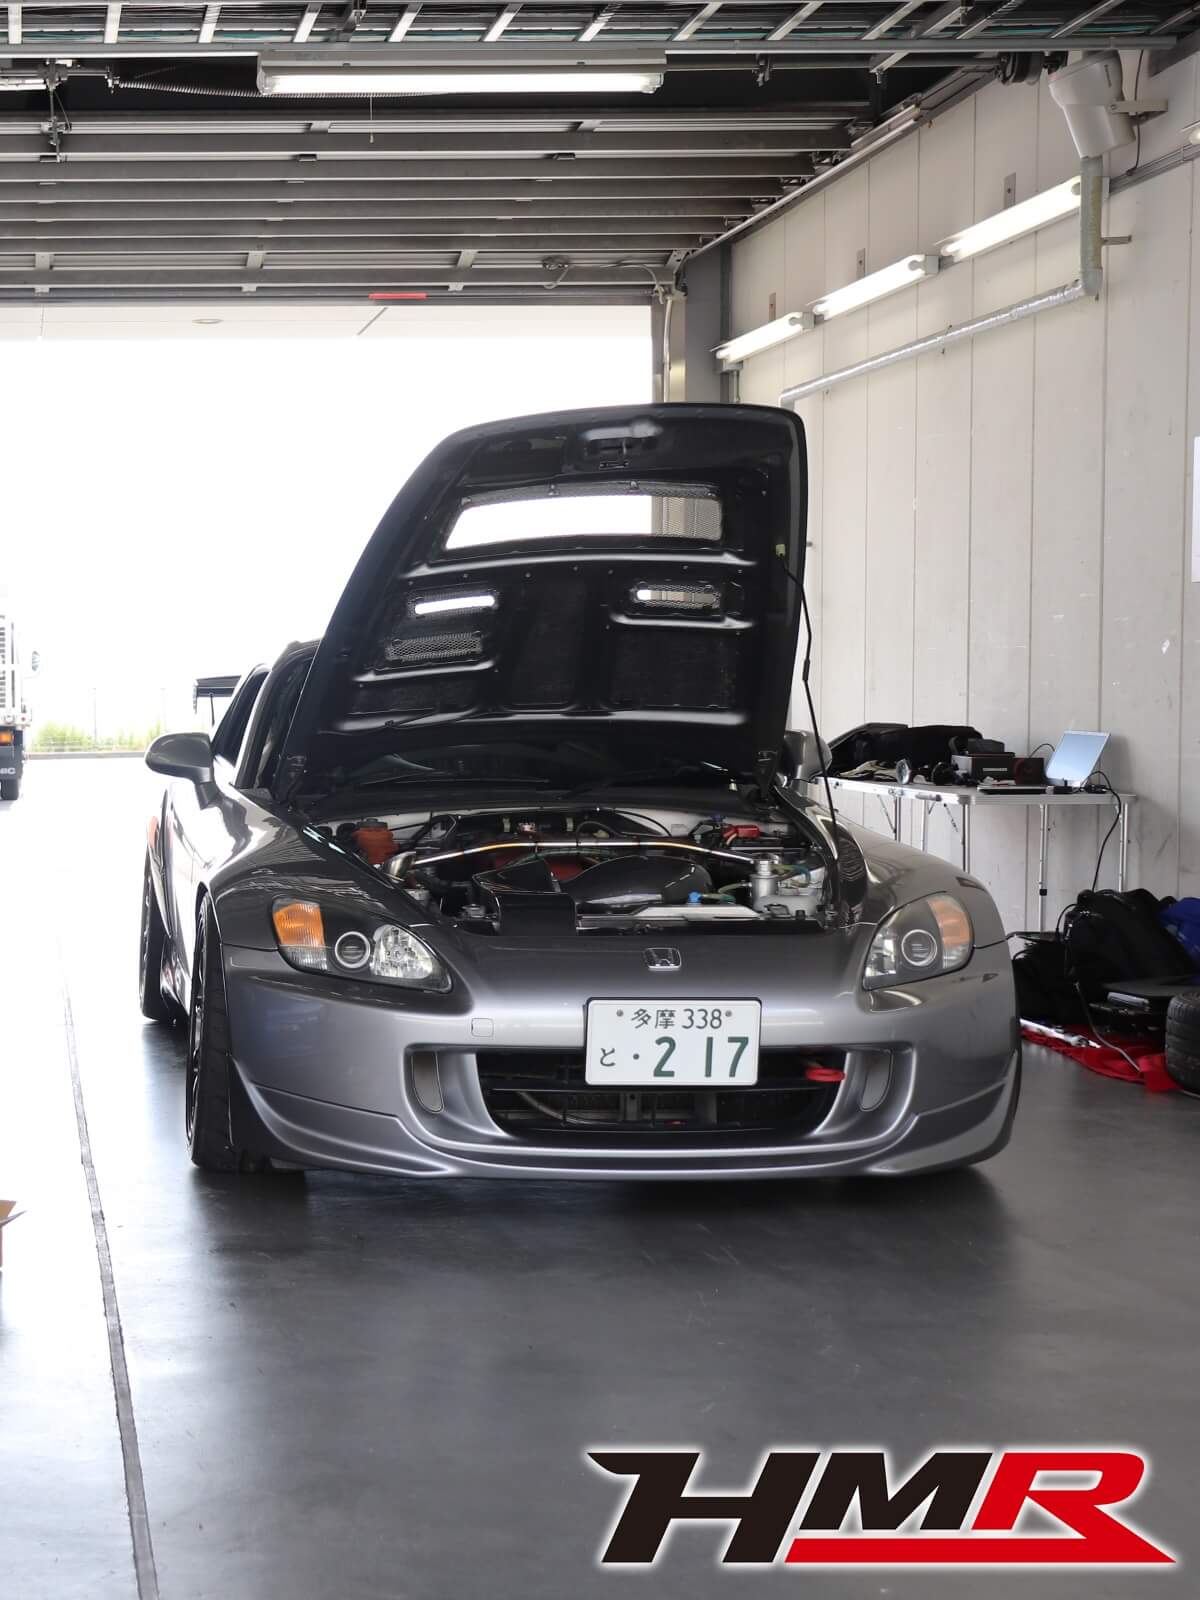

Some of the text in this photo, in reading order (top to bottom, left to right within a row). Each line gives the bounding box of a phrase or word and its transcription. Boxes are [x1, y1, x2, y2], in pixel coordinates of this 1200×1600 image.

[631, 1008, 722, 1029] 多摩 338
[600, 1047, 615, 1067] と
